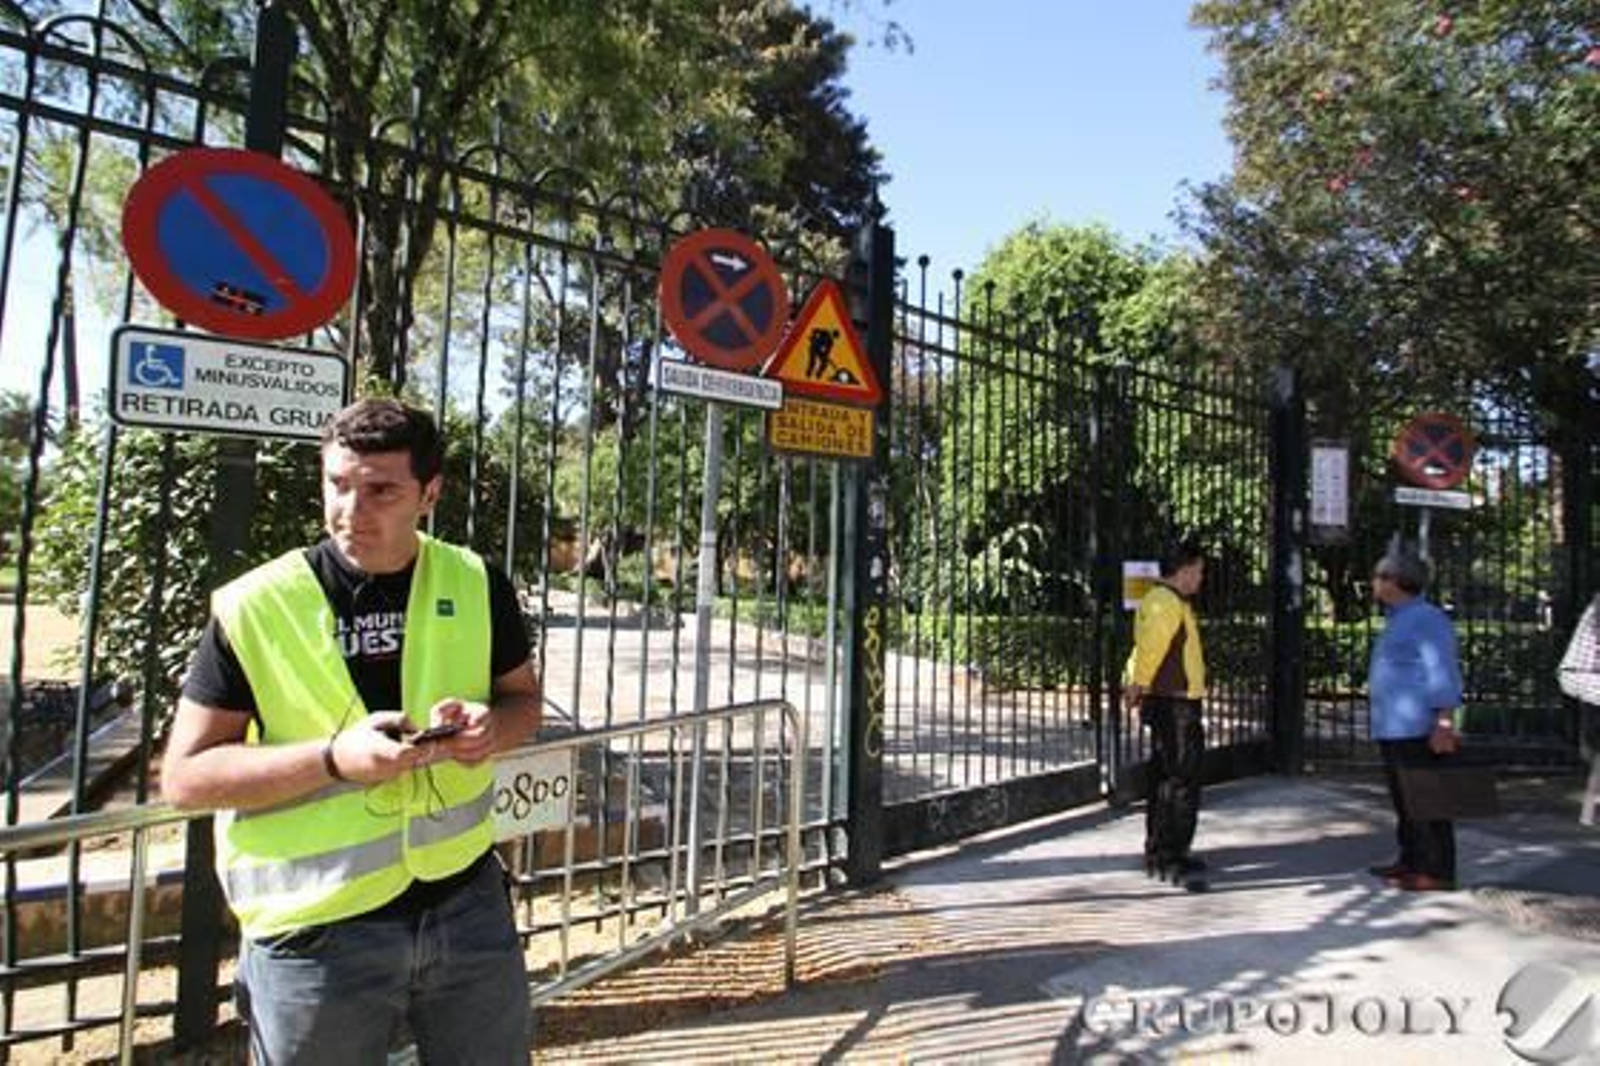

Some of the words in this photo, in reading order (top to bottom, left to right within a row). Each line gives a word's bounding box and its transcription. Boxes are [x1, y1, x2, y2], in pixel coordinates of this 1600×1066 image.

[225, 353, 315, 378] EXCEPTO
[195, 368, 340, 397] MINUSVALIDOS
[121, 393, 259, 422] RETIRADA
[785, 401, 851, 422] NTRADA
[776, 415, 837, 435] SALIDA
[847, 423, 868, 440] DE
[776, 430, 868, 452] CAMIONES
